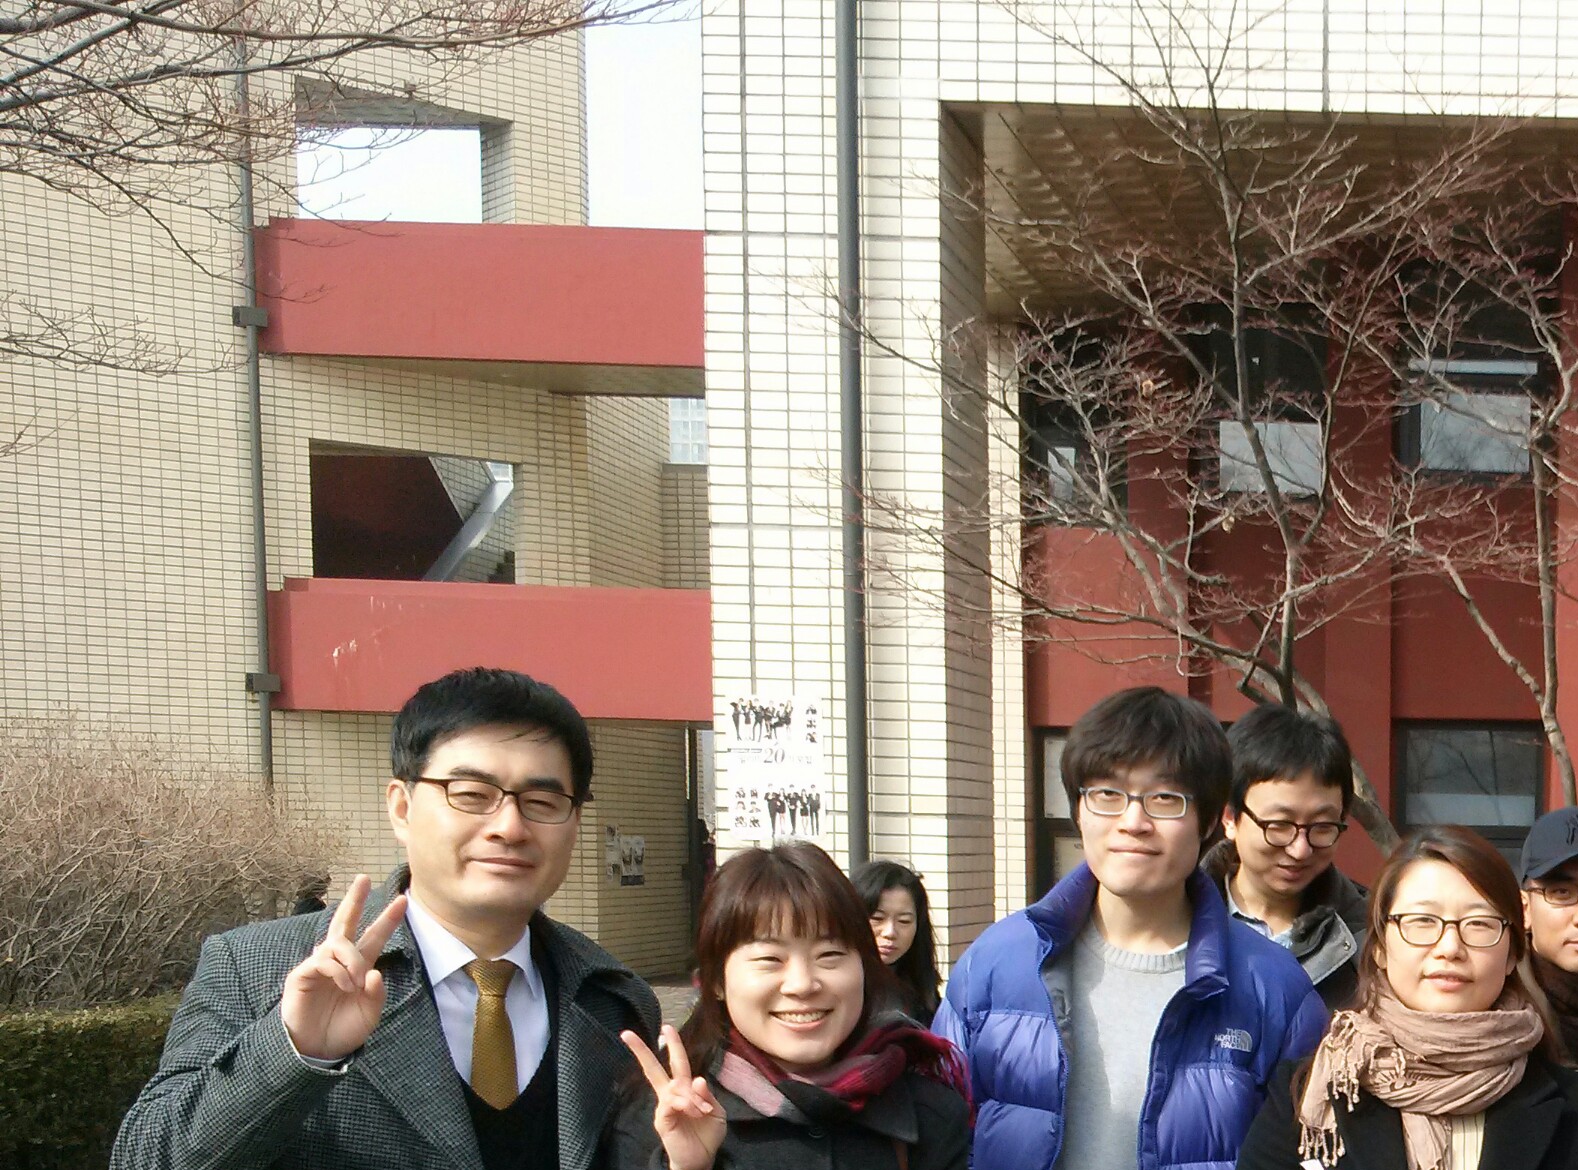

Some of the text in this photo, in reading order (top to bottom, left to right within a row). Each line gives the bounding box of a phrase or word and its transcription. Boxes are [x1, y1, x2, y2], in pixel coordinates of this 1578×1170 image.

[1226, 1027, 1242, 1036] THE
[1214, 1034, 1241, 1044] NORTH
[1220, 1041, 1241, 1051] FACE
